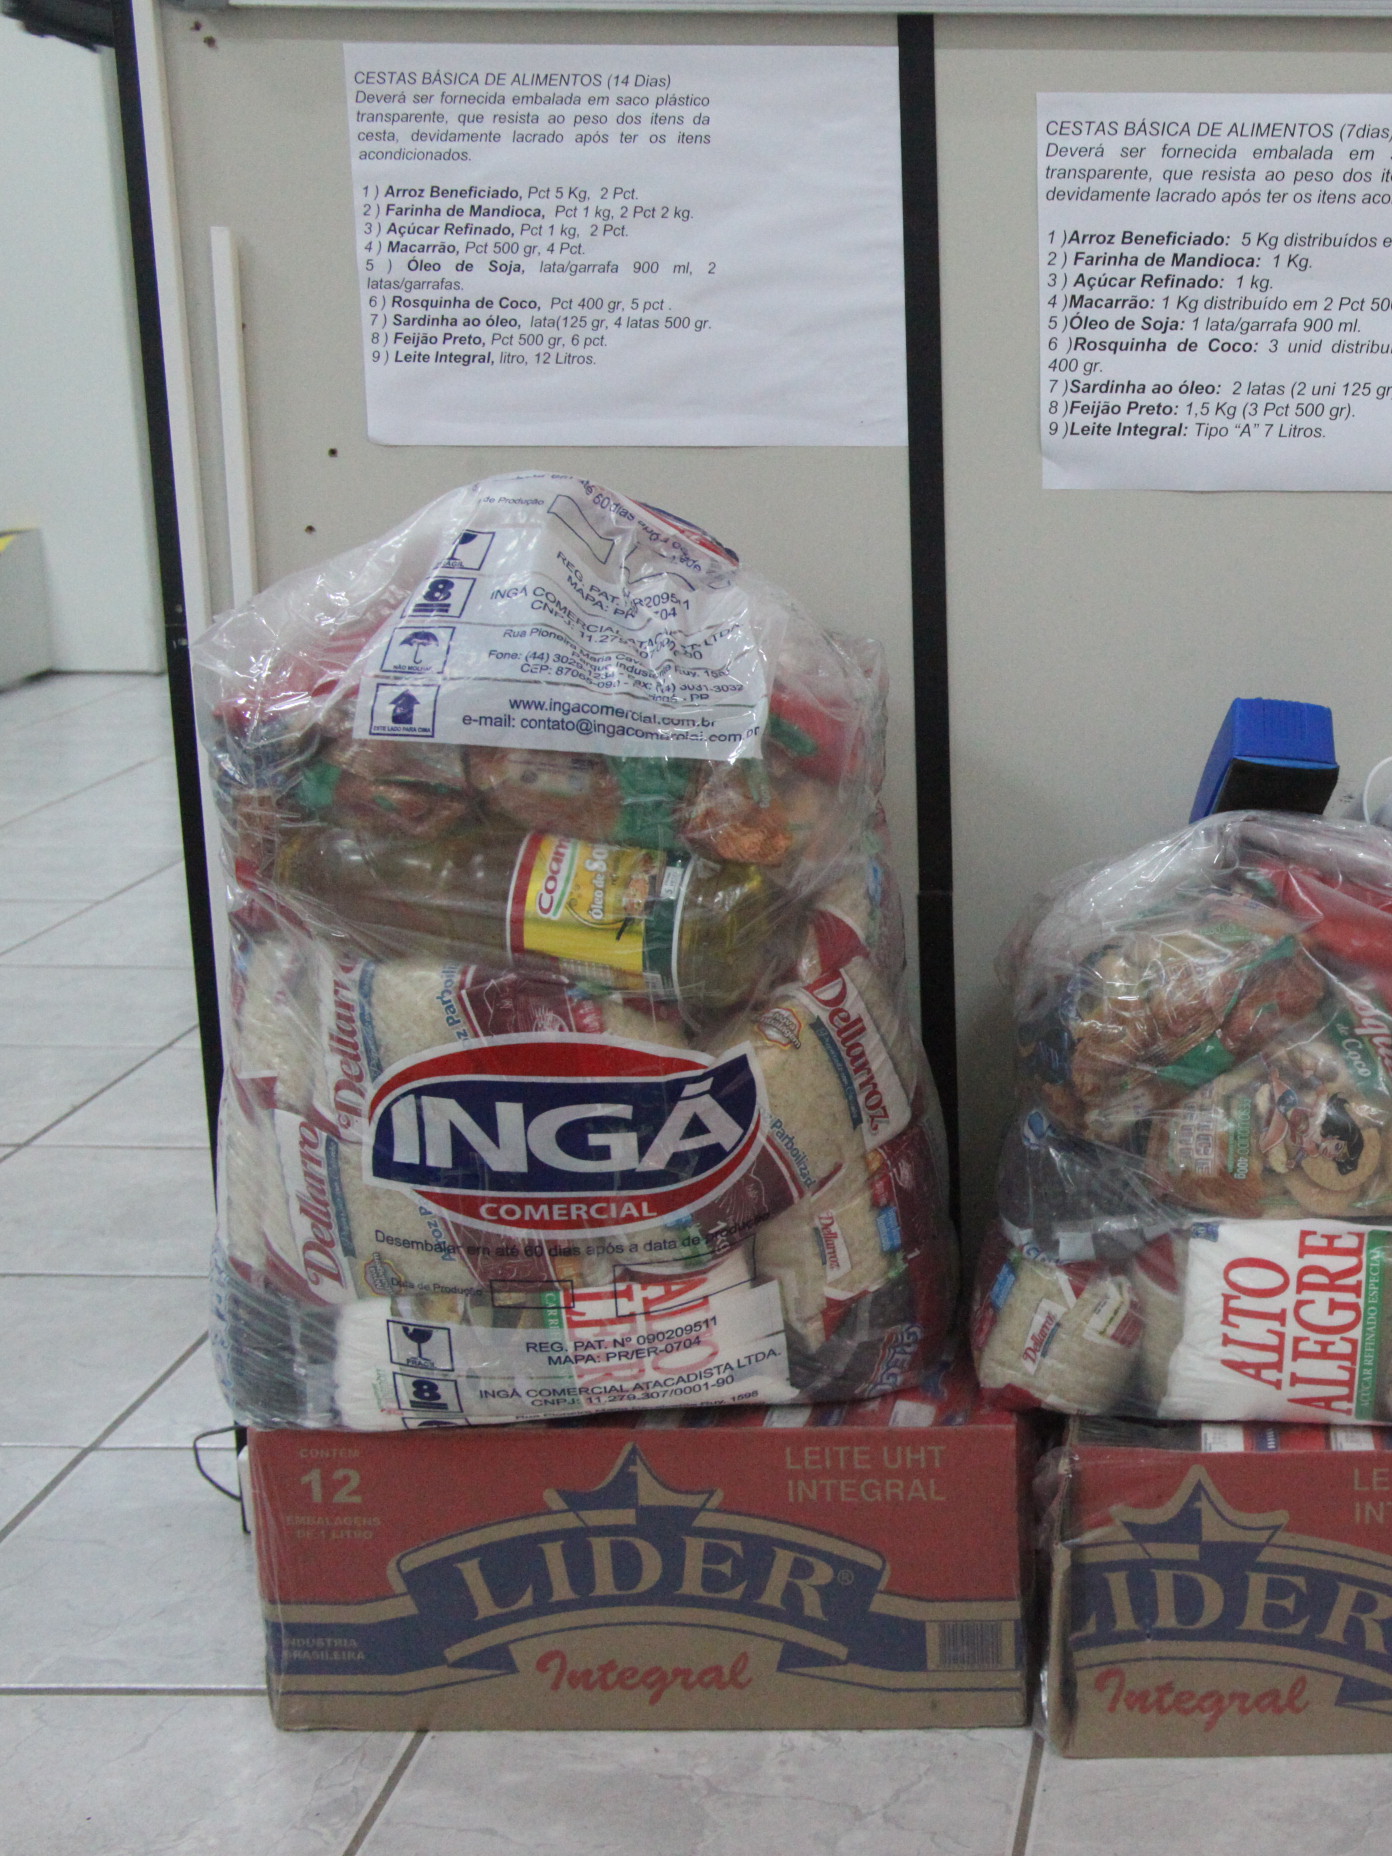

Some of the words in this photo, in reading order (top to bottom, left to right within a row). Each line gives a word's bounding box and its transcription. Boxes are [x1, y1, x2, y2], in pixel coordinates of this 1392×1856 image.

[353, 70, 418, 86] CESTAS
[421, 68, 480, 87] BÁSICA
[483, 71, 508, 87] DE
[509, 72, 603, 88] ALIMENTOS
[606, 73, 630, 91] (14
[633, 73, 672, 91] Dias)
[354, 89, 407, 105] Deverá
[411, 93, 436, 105] ser
[439, 90, 507, 106] fornecida
[511, 91, 582, 106] embalada
[586, 95, 611, 107] em
[614, 95, 650, 107] saco
[654, 92, 711, 110] plástico
[1045, 119, 1120, 137] CESTAS
[1123, 118, 1192, 138] BÁSICA
[1196, 121, 1224, 138] DE
[1226, 121, 1335, 139] ALIMENTOS
[357, 147, 472, 162] acondicionados.
[1045, 185, 1152, 203] devidamente
[1155, 186, 1217, 204] lacrado
[1220, 187, 1262, 207] após
[1266, 188, 1290, 204] ter
[1292, 191, 1313, 205] os
[1316, 188, 1357, 205] itens
[366, 276, 465, 294] latas/garrafas.
[1047, 357, 1079, 373] 400
[1082, 361, 1103, 377] gr.
[462, 714, 516, 729] e-mail:
[537, 838, 570, 916] Coam
[801, 970, 890, 1132] Dellarroz
[389, 1075, 743, 1175] INGÁ
[298, 1121, 347, 1290] Dellarro
[479, 1201, 658, 1222] COMERCIAL
[585, 1240, 625, 1260] após
[643, 1237, 678, 1253] data
[681, 1233, 701, 1248] de
[525, 1340, 569, 1353] REG.
[573, 1338, 607, 1352] PAT.
[636, 1315, 719, 1346] 090209511
[1219, 1256, 1291, 1391] ALTO
[1286, 1229, 1366, 1417] ALEGRE
[1362, 1306, 1379, 1367] REFINADO
[547, 1352, 601, 1367] MAPA:
[606, 1335, 702, 1363] PR/ER-0704
[525, 1382, 632, 1399] COMERCIAL
[631, 1362, 735, 1393] ATACADISTA
[736, 1347, 783, 1369] LTDA.
[411, 1379, 442, 1402] 8
[784, 1445, 872, 1470] LEITE
[882, 1445, 948, 1470] UHT
[299, 1467, 363, 1505] 12
[787, 1478, 947, 1503] INTEGRAL
[453, 1535, 837, 1621] LIDER
[535, 1647, 754, 1705] Integral
[1094, 1667, 1309, 1733] Integral
